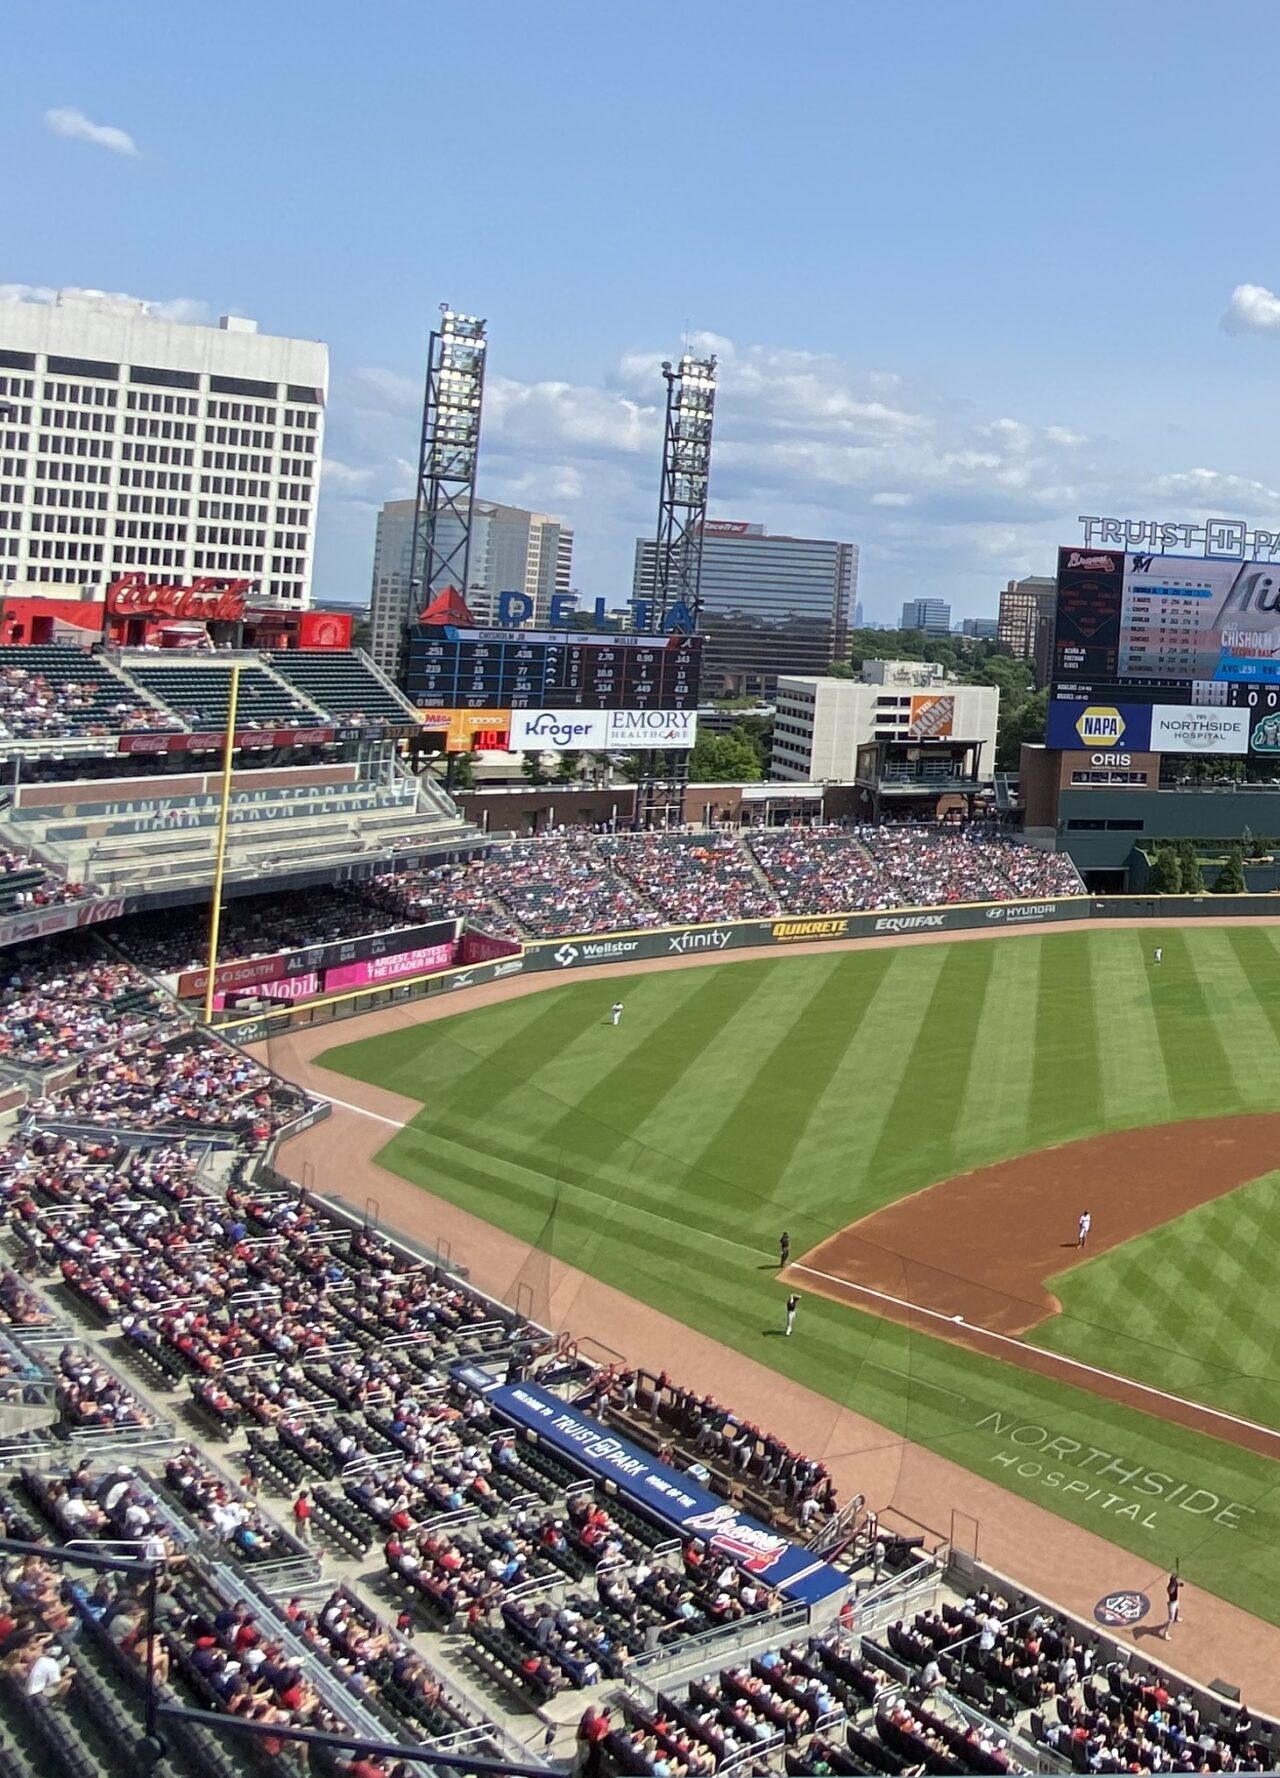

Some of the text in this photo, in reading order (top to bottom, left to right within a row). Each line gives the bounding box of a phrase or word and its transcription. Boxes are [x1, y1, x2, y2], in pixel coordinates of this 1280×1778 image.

[1078, 516, 1200, 548] TRUIST
[500, 591, 694, 634] DELTA
[1248, 692, 1258, 706] 0
[1267, 692, 1277, 707] 0
[612, 711, 693, 728] EMORY
[1084, 717, 1117, 736] NAPA
[1159, 720, 1241, 732] NORTHSIDE
[340, 730, 359, 740] 4:11
[525, 713, 593, 746] Kroger
[611, 729, 688, 739] HEALTHCARE
[1174, 732, 1226, 740] HOSPITAL
[1091, 753, 1131, 766] ORIS
[1006, 905, 1056, 917] HYUNDAI
[772, 919, 849, 938] QUIKRETE
[874, 914, 948, 931] EQUIFAX
[582, 941, 639, 956] Wellstar
[668, 929, 733, 953] xfinity
[234, 963, 274, 981] SOUTH
[287, 957, 304, 971] AL
[368, 955, 448, 979] THE LEADER IN 5G
[550, 1414, 602, 1445] TRUIST
[605, 1449, 649, 1477] PARK
[975, 1411, 1256, 1530] NORTHSIDE
[644, 1473, 668, 1492] HOME
[665, 1485, 678, 1498] OF
[989, 1451, 1159, 1529] HOSPITAL
[674, 1491, 697, 1508] THE
[682, 1504, 793, 1548] Braves
